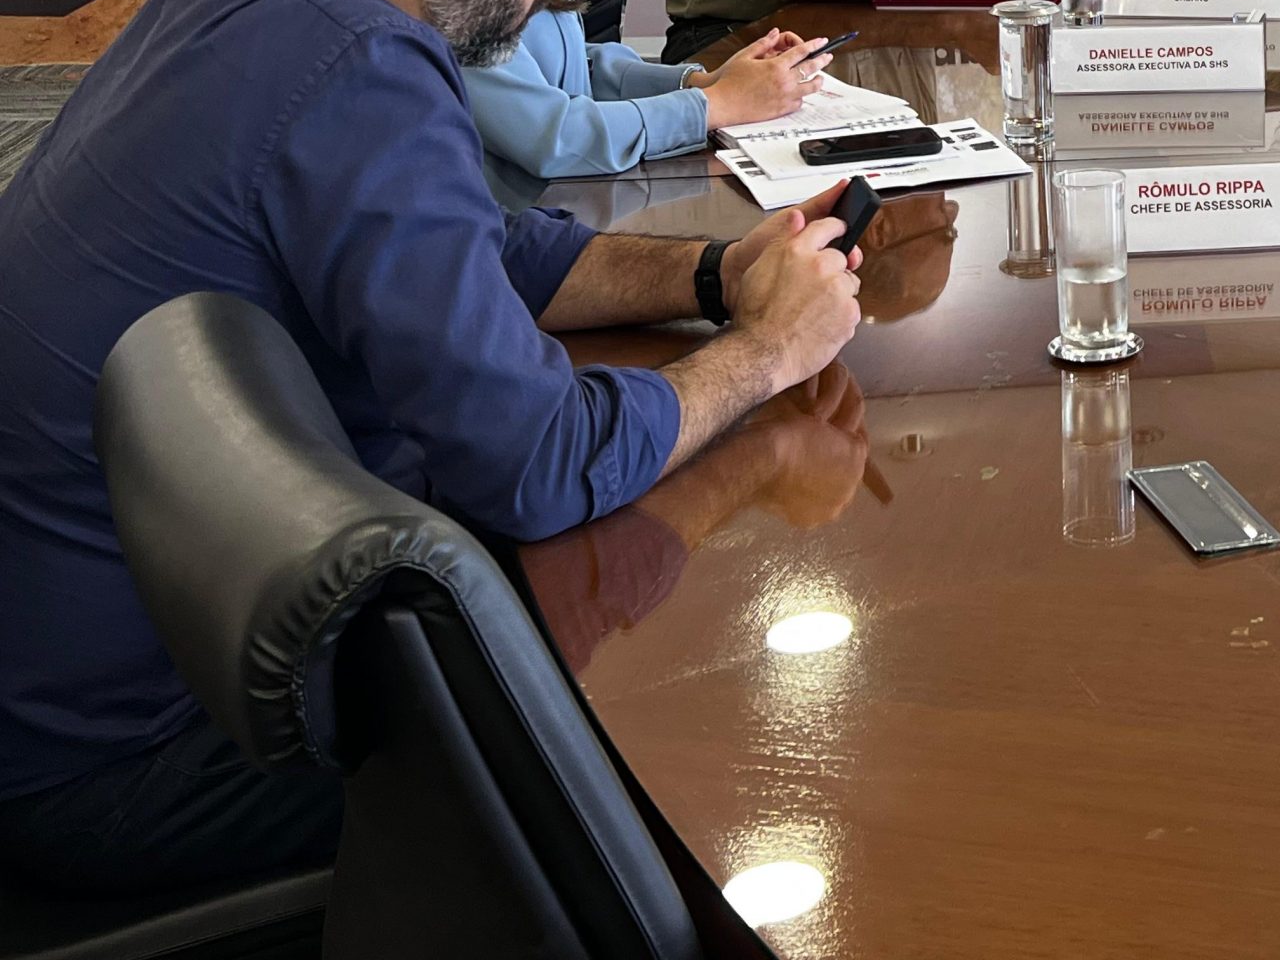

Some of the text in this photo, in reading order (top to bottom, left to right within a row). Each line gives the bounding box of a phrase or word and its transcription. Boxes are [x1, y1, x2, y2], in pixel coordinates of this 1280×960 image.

[1089, 46, 1214, 60] DANIELLE CAMPOS
[1077, 60, 1229, 72] ASSESSORA EXECUTIVA DA SHS
[1138, 180, 1265, 198] RÔMULO RIPPA
[1130, 198, 1273, 214] CHEFE DE ASSESSORIA
